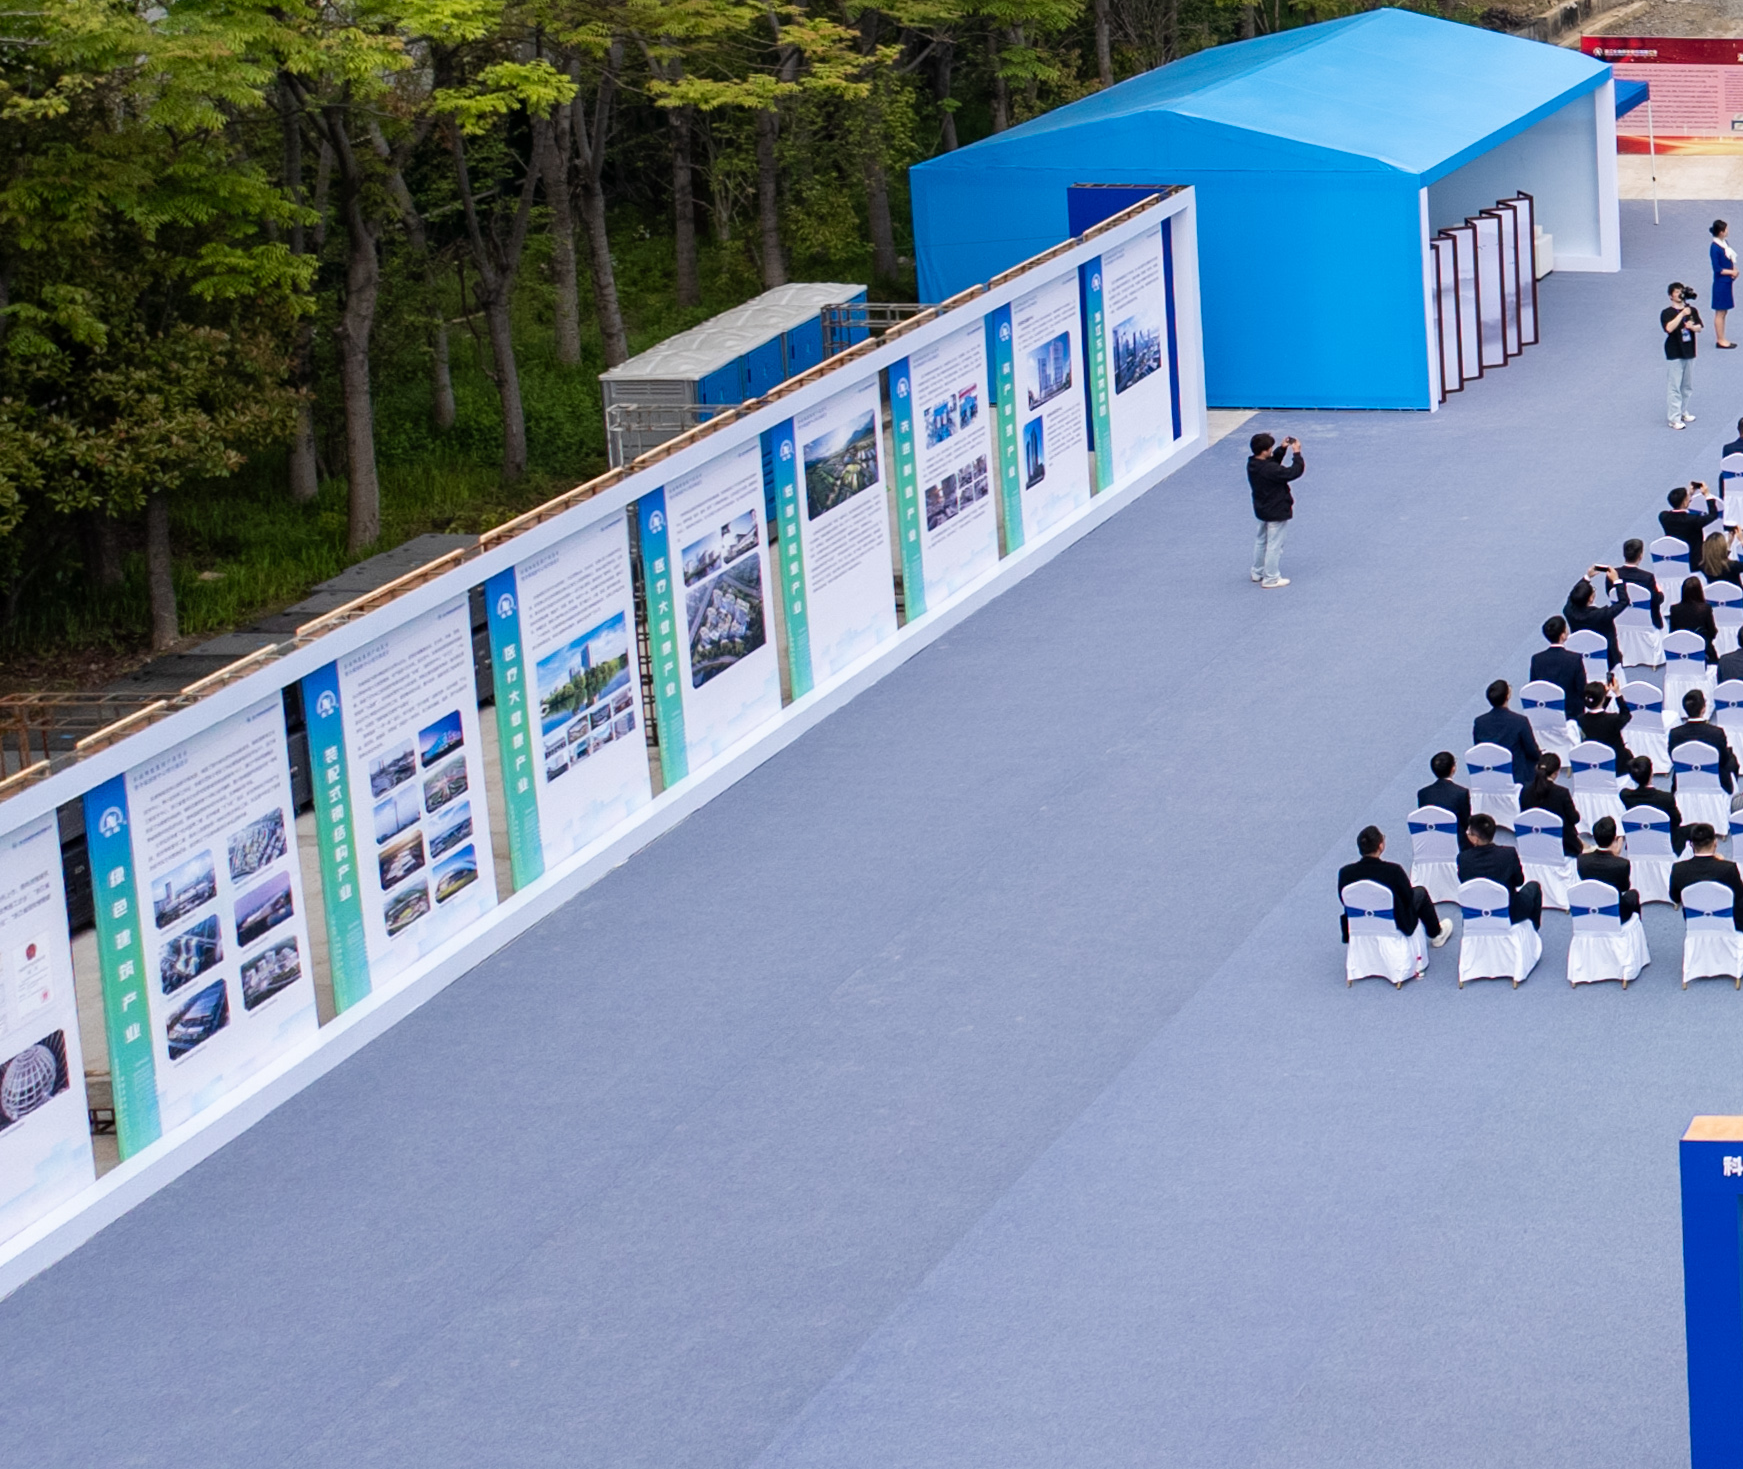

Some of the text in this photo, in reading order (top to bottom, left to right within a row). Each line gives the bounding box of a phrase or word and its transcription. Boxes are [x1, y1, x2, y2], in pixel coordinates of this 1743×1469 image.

[108, 866, 142, 1045] 绿色建筑产业
